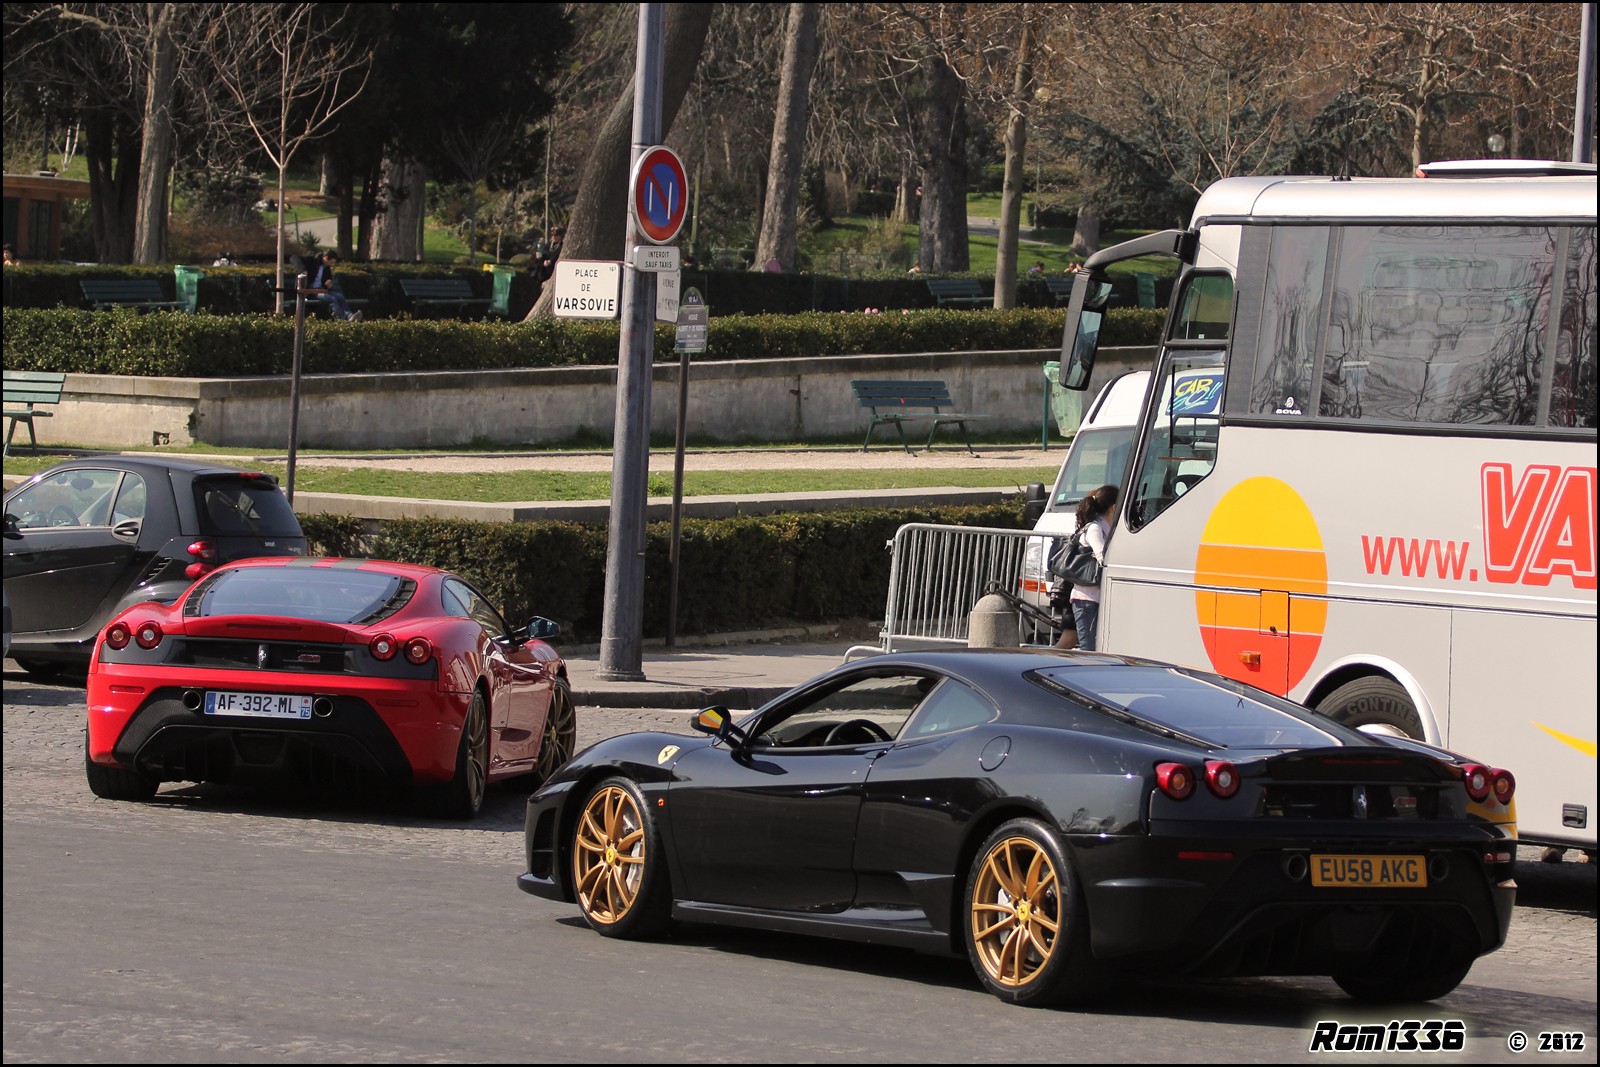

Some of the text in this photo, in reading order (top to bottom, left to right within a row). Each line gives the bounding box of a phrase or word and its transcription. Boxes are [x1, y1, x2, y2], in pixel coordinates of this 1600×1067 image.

[575, 269, 598, 278] PLACE
[581, 283, 591, 292] DE
[556, 297, 615, 312] VARSOVIE
[217, 694, 297, 714] AF-392-ML
[301, 708, 310, 718] 75
[1320, 858, 1419, 883] EU58 AKG
